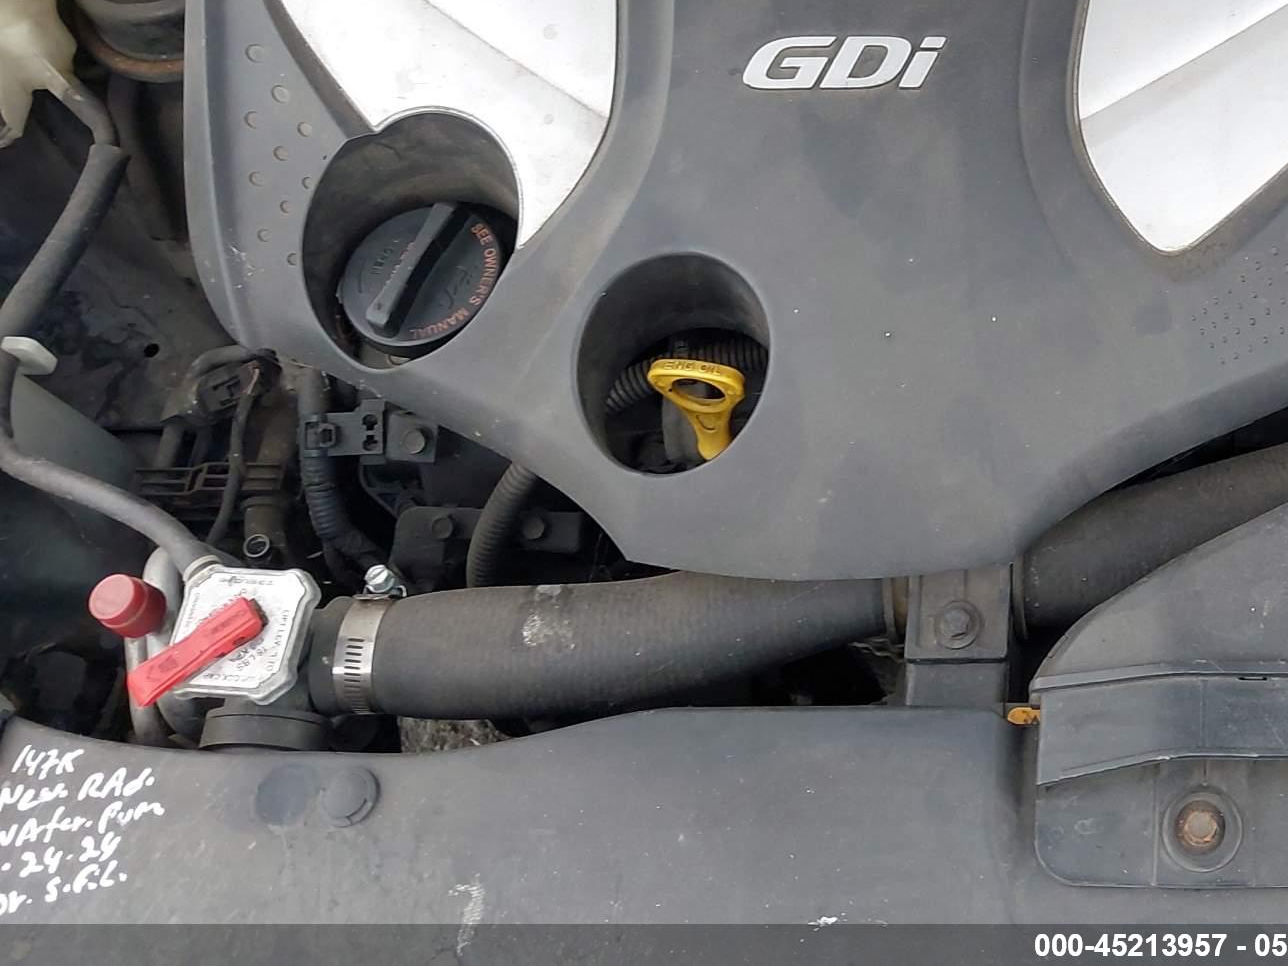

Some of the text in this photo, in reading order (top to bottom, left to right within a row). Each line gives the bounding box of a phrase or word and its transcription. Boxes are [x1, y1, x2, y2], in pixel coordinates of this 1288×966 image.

[742, 35, 947, 89] GDi
[471, 223, 493, 246] SEE
[409, 307, 469, 339] MANUAL
